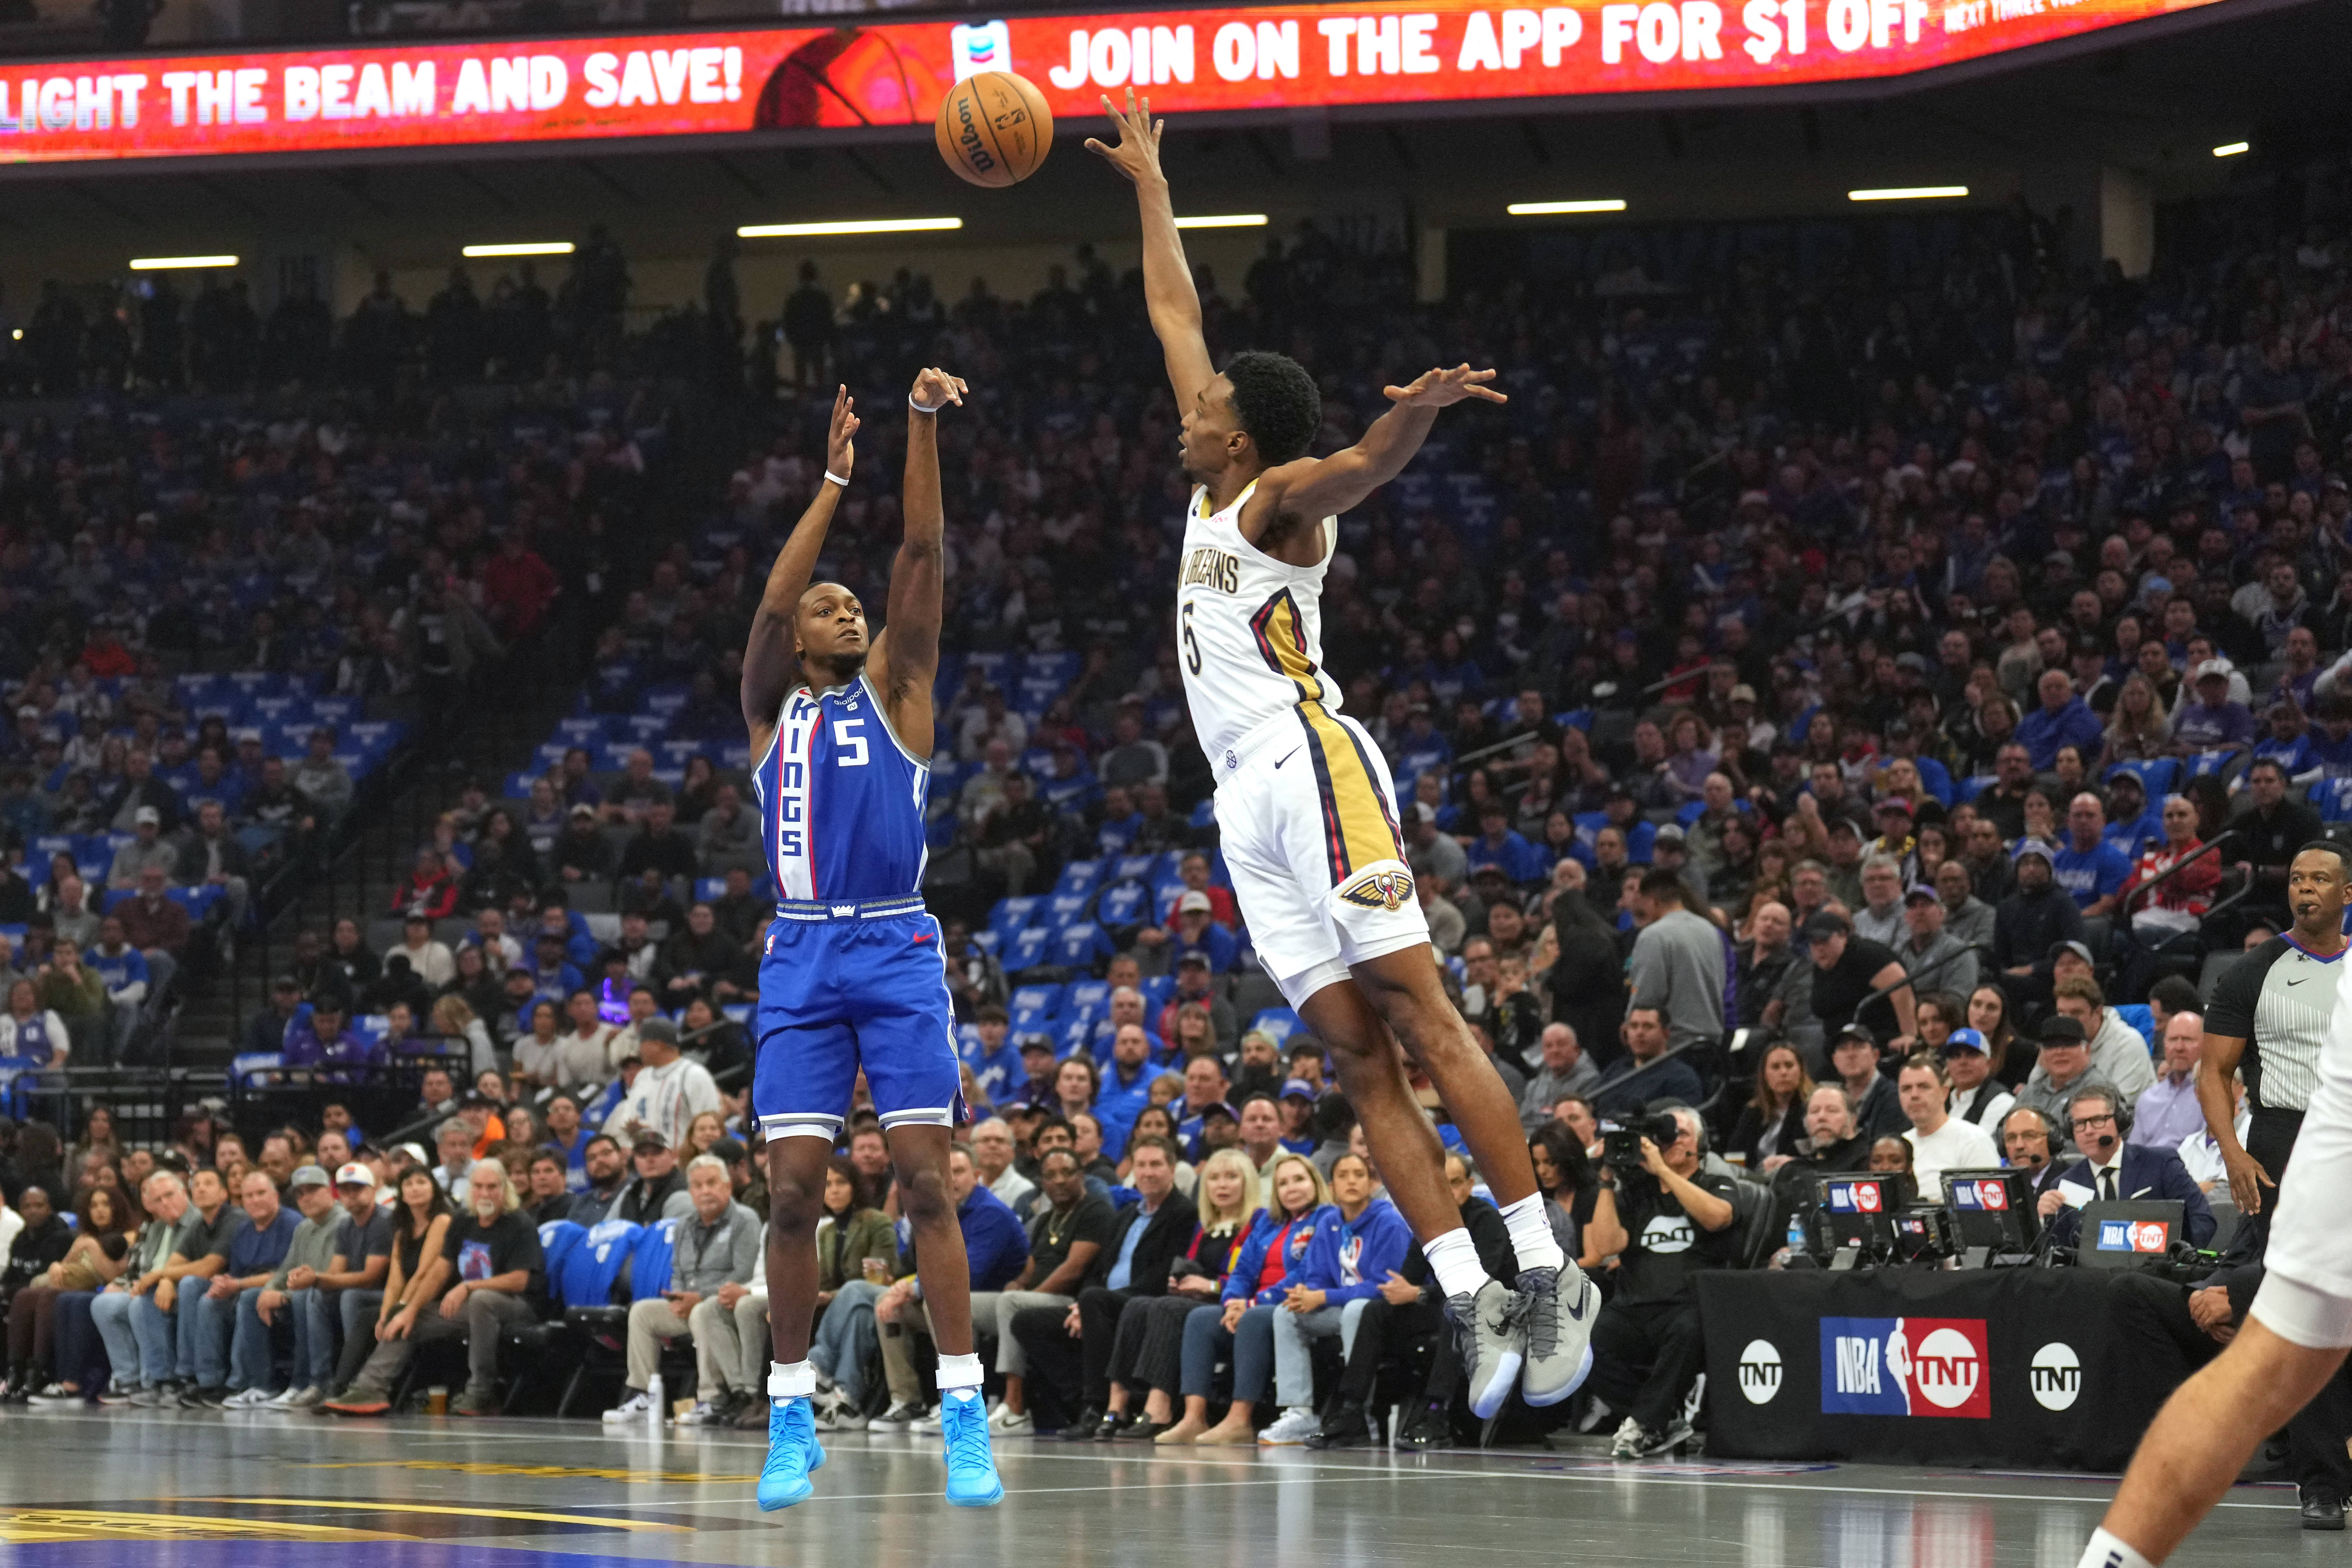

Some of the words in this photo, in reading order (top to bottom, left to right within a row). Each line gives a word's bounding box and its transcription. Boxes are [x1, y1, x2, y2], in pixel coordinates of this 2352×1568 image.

[1049, 24, 1195, 89] JOIN
[1213, 21, 1299, 82] ON
[1318, 15, 1440, 77] THE
[1457, 7, 1582, 71] APP
[1602, 1, 1723, 64] FOR
[1743, 0, 1807, 64] $1
[1827, 0, 1929, 52] OFF
[0, 73, 148, 133] LIGHT
[162, 69, 268, 126] THE
[284, 60, 436, 120] BEAM
[452, 55, 568, 113] AND
[584, 46, 742, 107] SAVE!
[957, 97, 995, 173] Wilson
[1182, 600, 1201, 678] 5
[834, 685, 864, 705] dialpad
[833, 719, 869, 767] 5
[782, 696, 819, 857] KINGS
[2102, 1226, 2124, 1245] NBA
[1739, 1362, 1782, 1386] TNT
[1836, 1336, 1881, 1394] NBA
[1916, 1356, 1979, 1386] TNT
[2031, 1366, 2081, 1391] TNT
